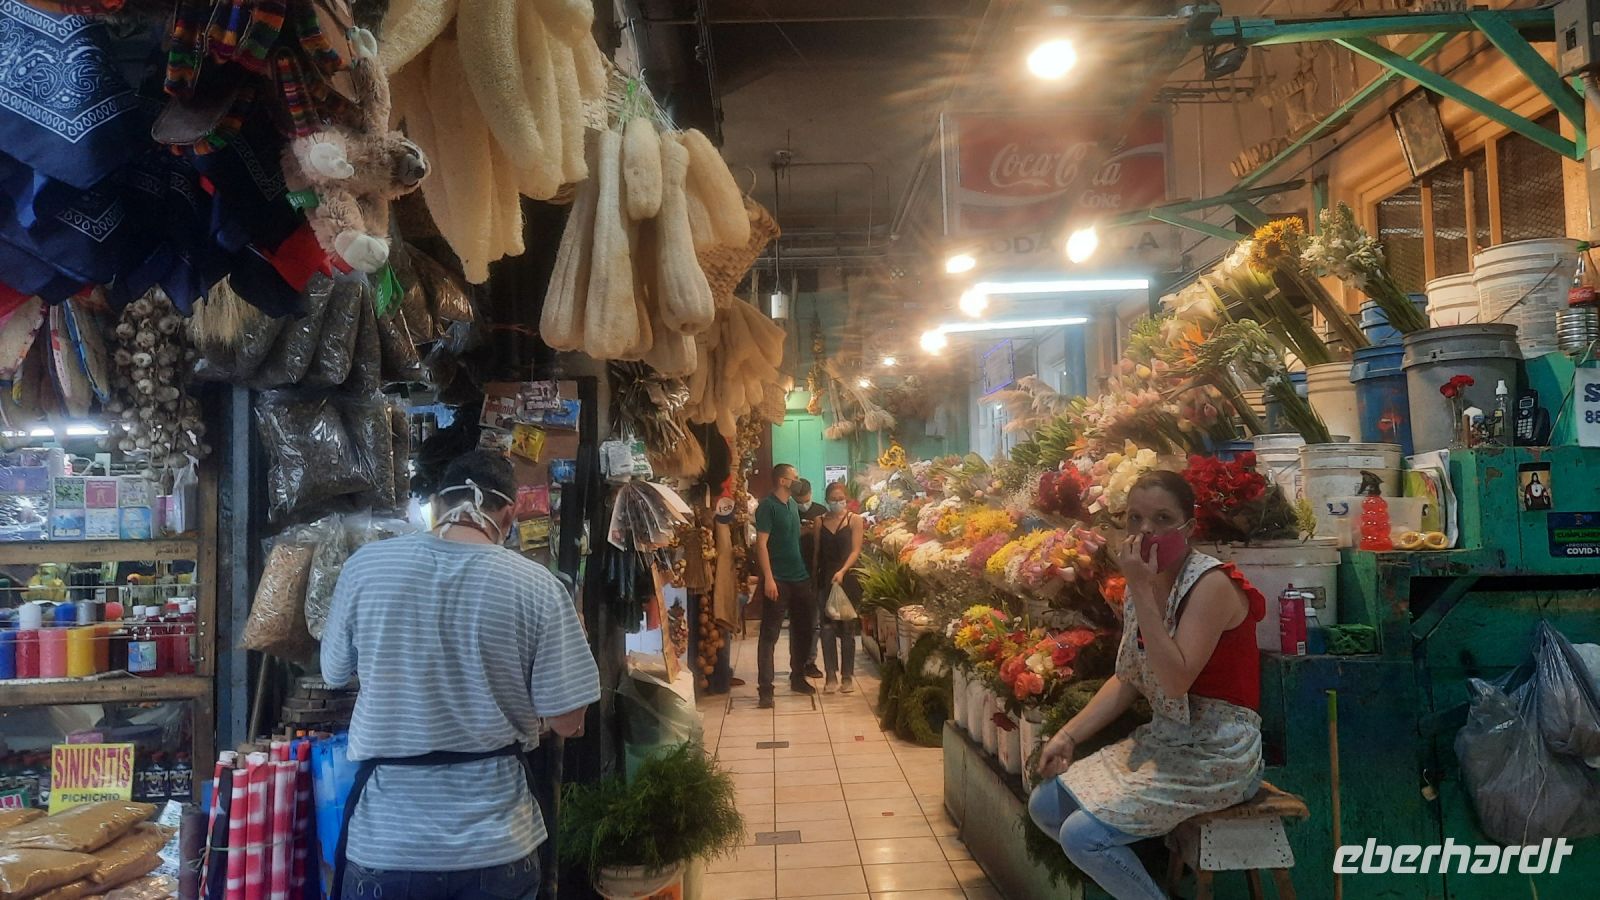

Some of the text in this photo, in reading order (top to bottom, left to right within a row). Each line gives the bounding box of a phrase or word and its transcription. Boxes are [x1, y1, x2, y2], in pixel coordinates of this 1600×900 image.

[989, 142, 1121, 187] Coca-Ca
[1080, 190, 1121, 208] Coke
[1566, 547, 1600, 555] COVID-1
[54, 748, 131, 789] SINUSITIS
[61, 792, 120, 803] PICHICHIO
